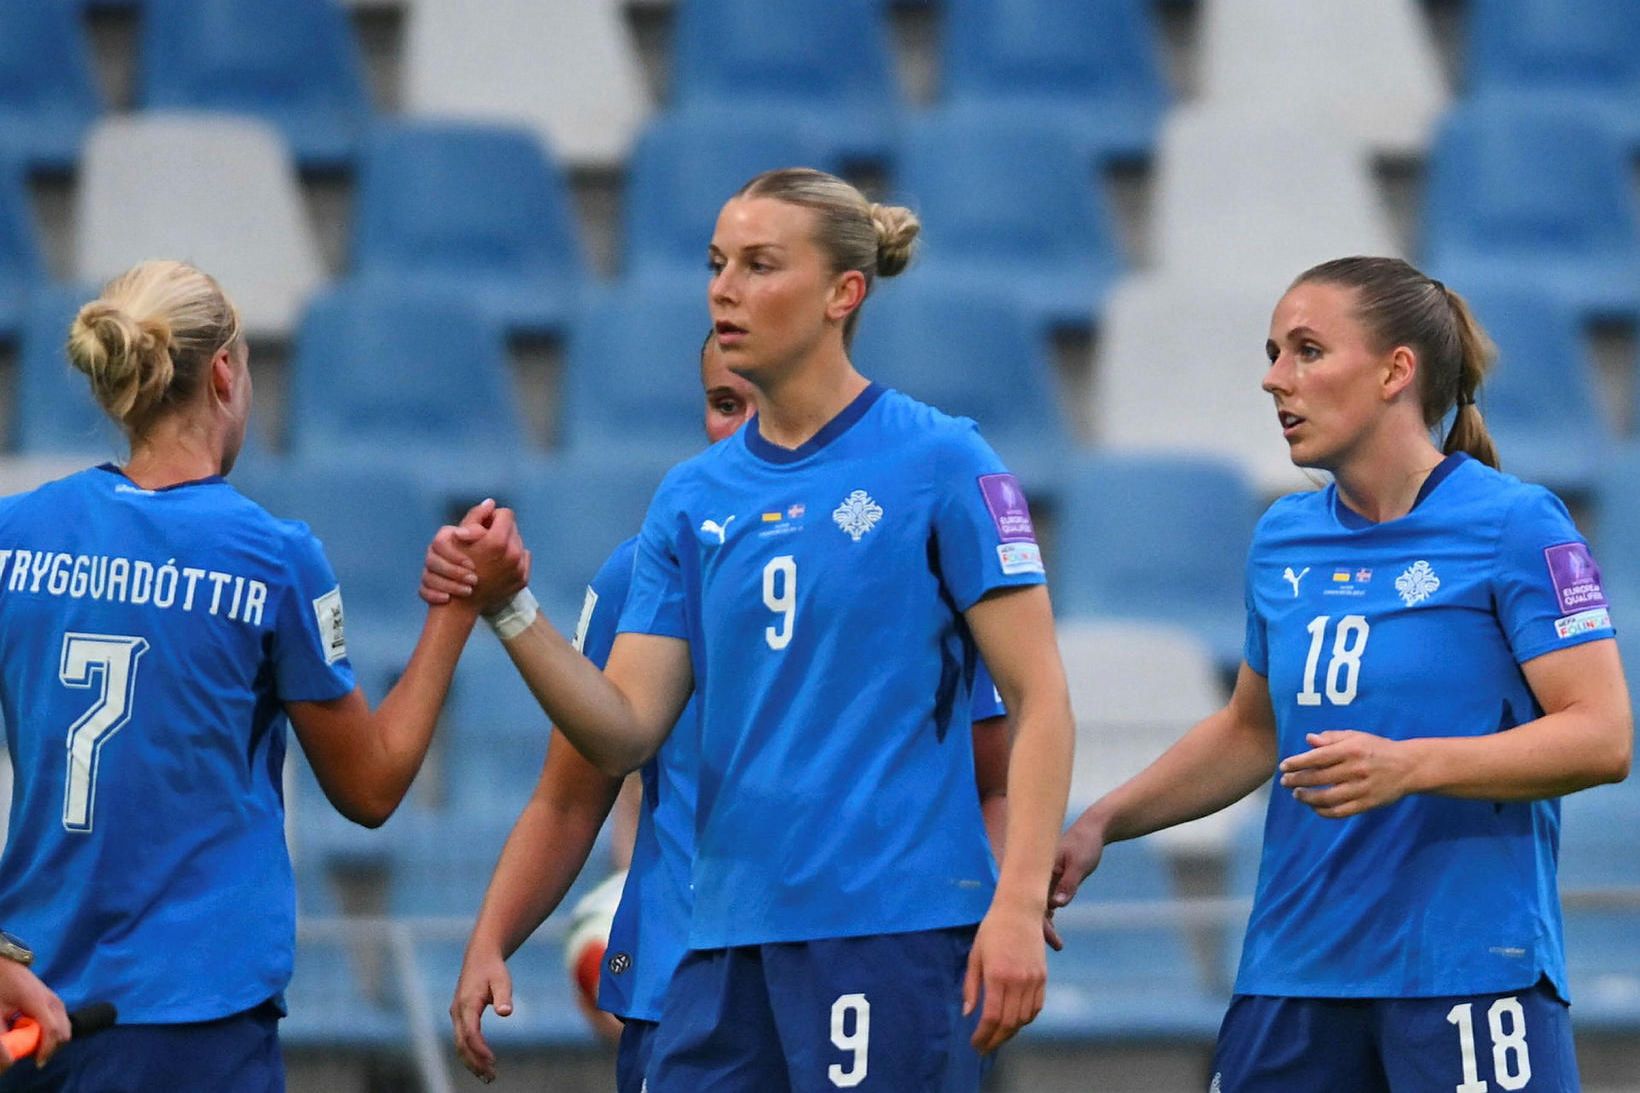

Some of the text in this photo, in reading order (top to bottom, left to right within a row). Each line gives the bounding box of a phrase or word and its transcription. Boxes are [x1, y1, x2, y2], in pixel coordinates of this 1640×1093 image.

[763, 555, 797, 650] 9
[1297, 615, 1370, 705] 18
[59, 632, 150, 832] 7
[828, 993, 870, 1088] 9
[1446, 996, 1532, 1093] 18
